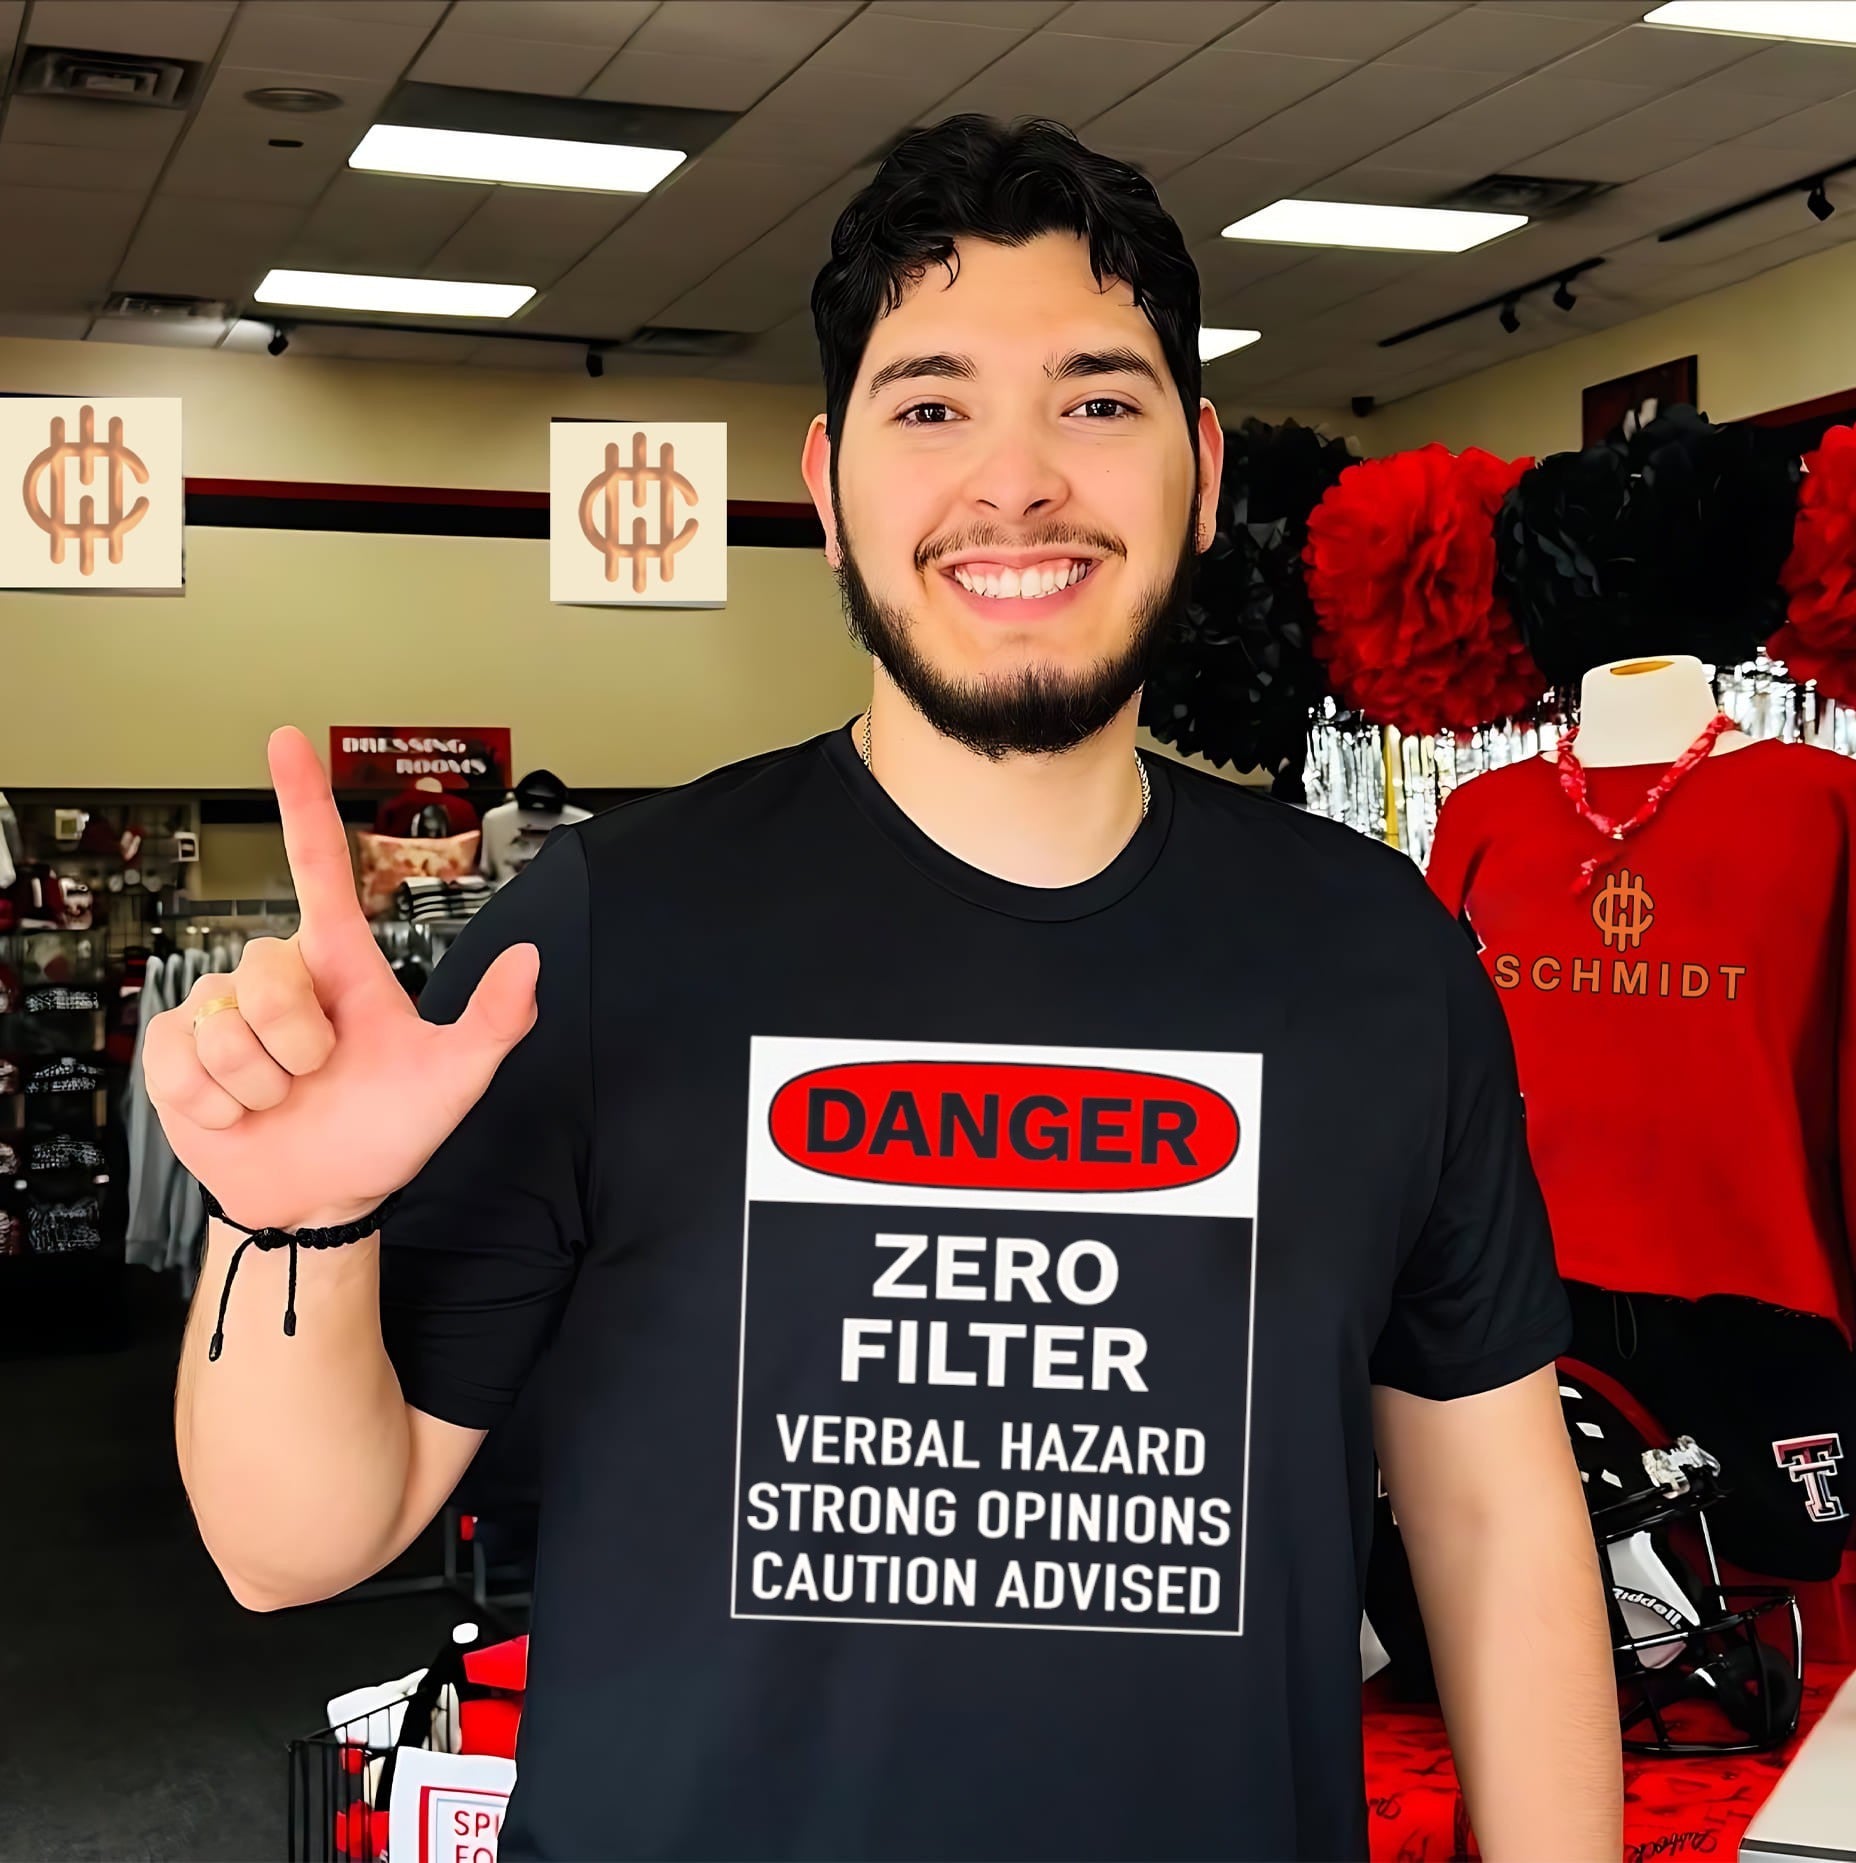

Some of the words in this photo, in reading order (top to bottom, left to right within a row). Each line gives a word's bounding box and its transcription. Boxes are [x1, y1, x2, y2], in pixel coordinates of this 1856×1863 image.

[396, 758, 487, 775] ROOMS
[1494, 954, 1747, 1001] SCHMIDT
[806, 1087, 1199, 1167] DANGER
[873, 1233, 1118, 1305] ZERO
[841, 1318, 1148, 1392] FILTER
[776, 1414, 980, 1468] VERBAL
[1001, 1422, 1205, 1476] HAZARD
[747, 1482, 956, 1537] STRONG
[978, 1490, 1231, 1546] OPINIONS
[752, 1551, 976, 1606] CAUTION
[995, 1560, 1220, 1614] ADVISED
